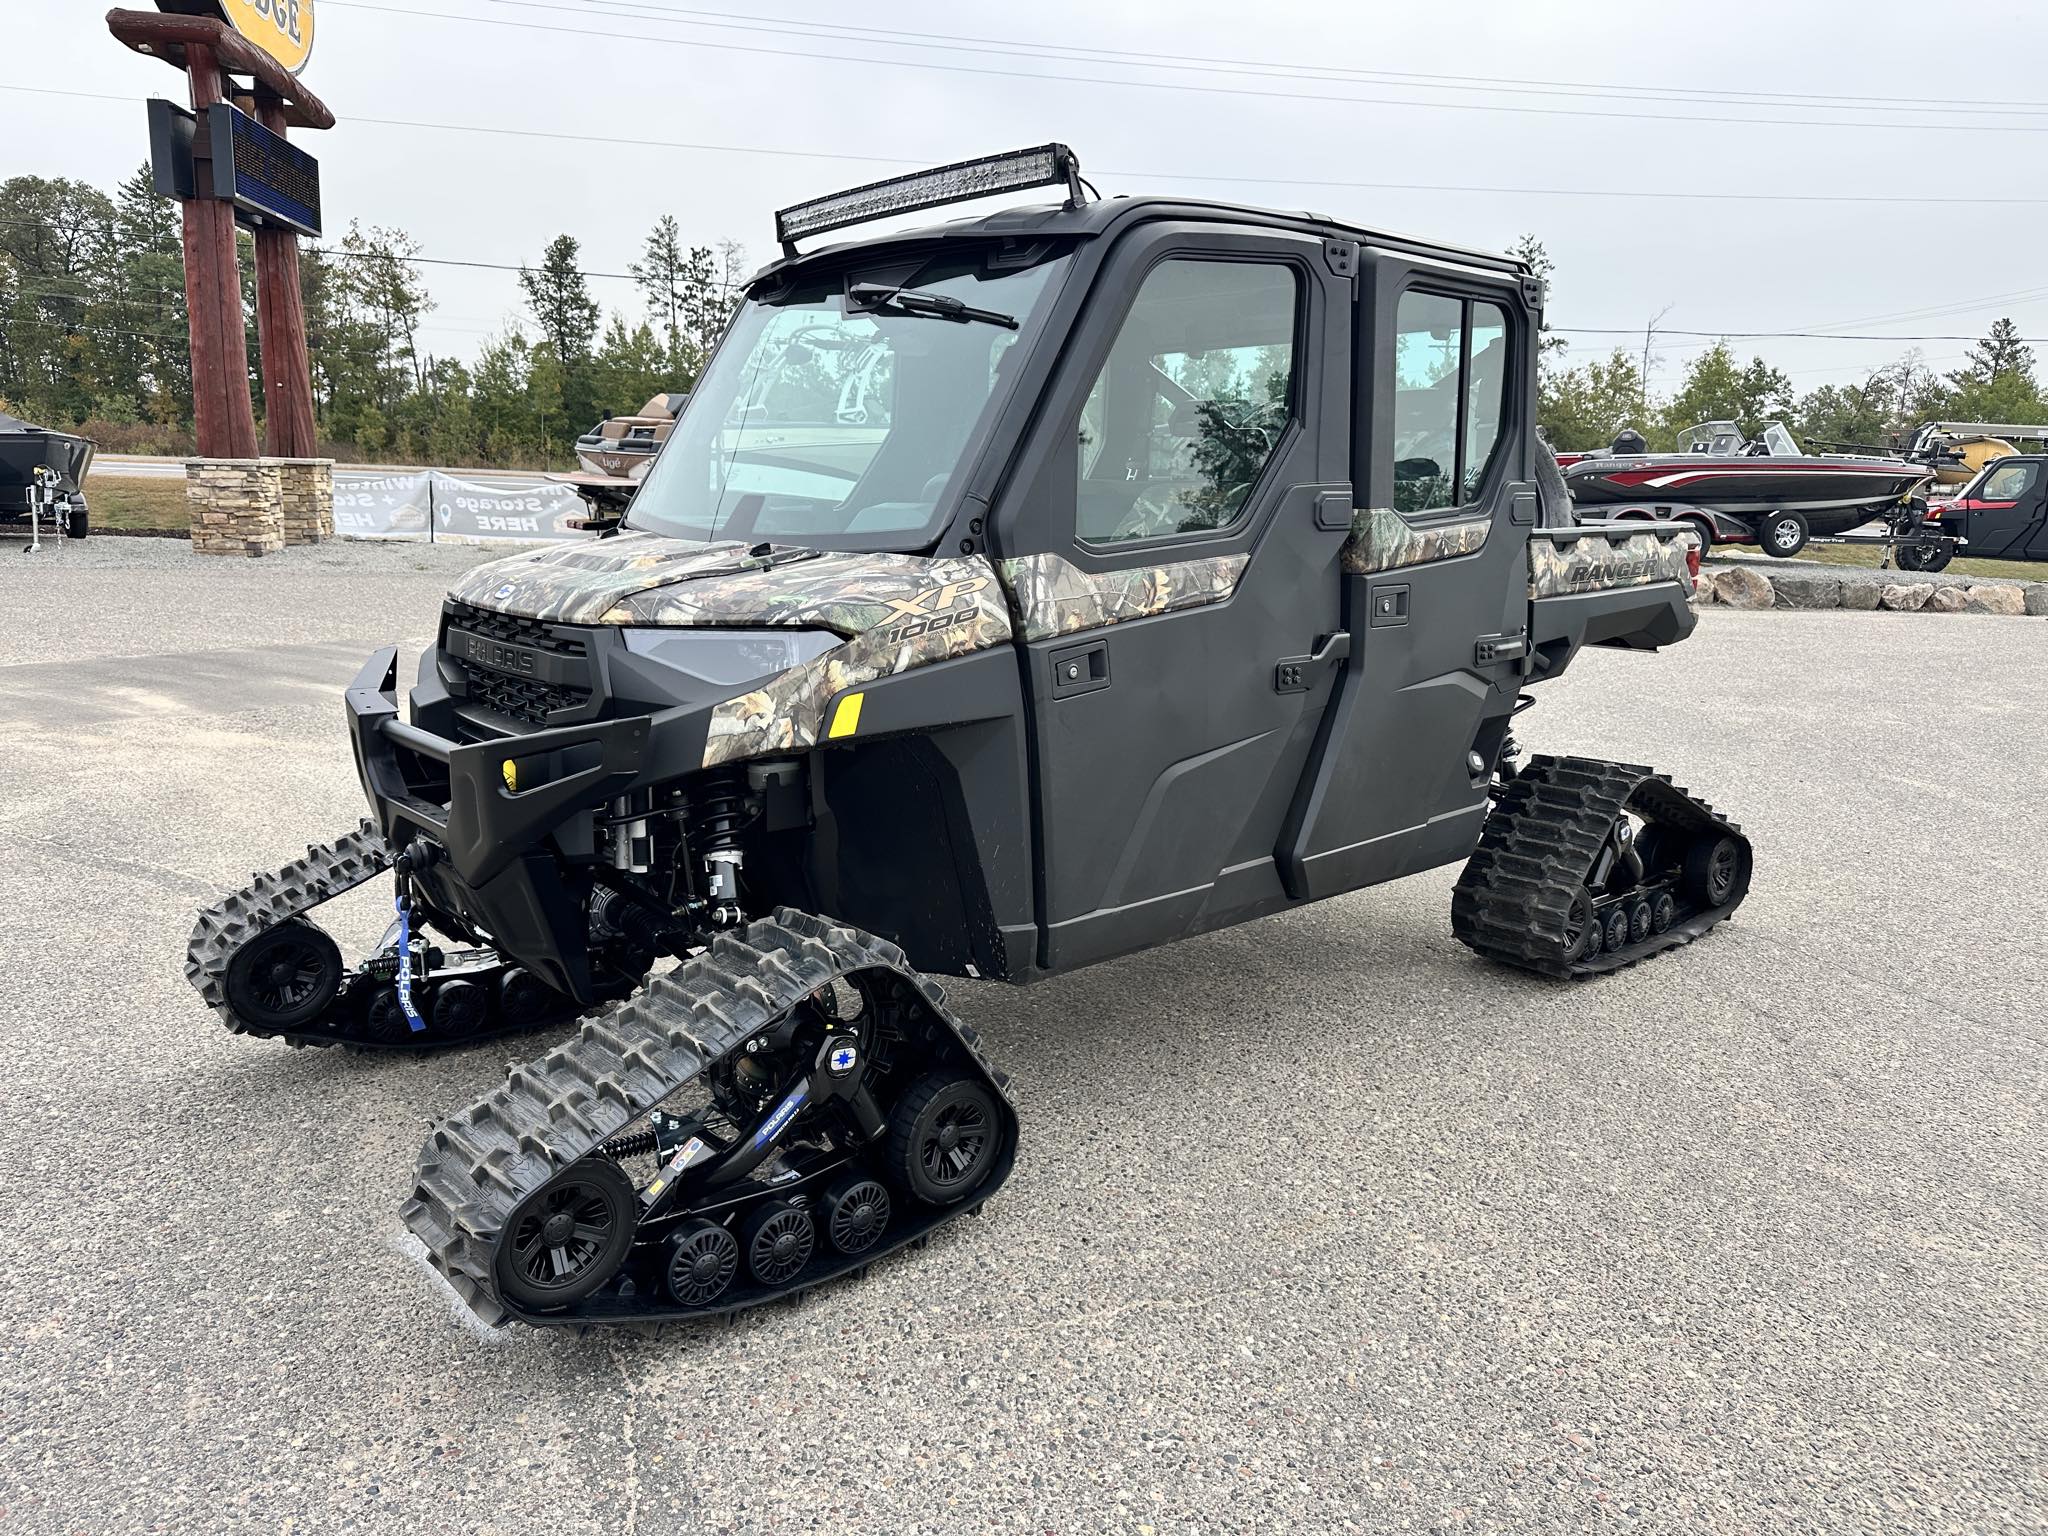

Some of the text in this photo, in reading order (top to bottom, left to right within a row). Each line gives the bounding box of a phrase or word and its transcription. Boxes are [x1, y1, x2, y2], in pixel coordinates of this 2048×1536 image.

[1569, 559, 1659, 585] RANGER
[870, 575, 991, 630] XP
[888, 605, 981, 645] 1000
[467, 636, 535, 674] POLARIS
[400, 955, 418, 1019] POLARIS
[761, 1100, 794, 1136] POLARIS
